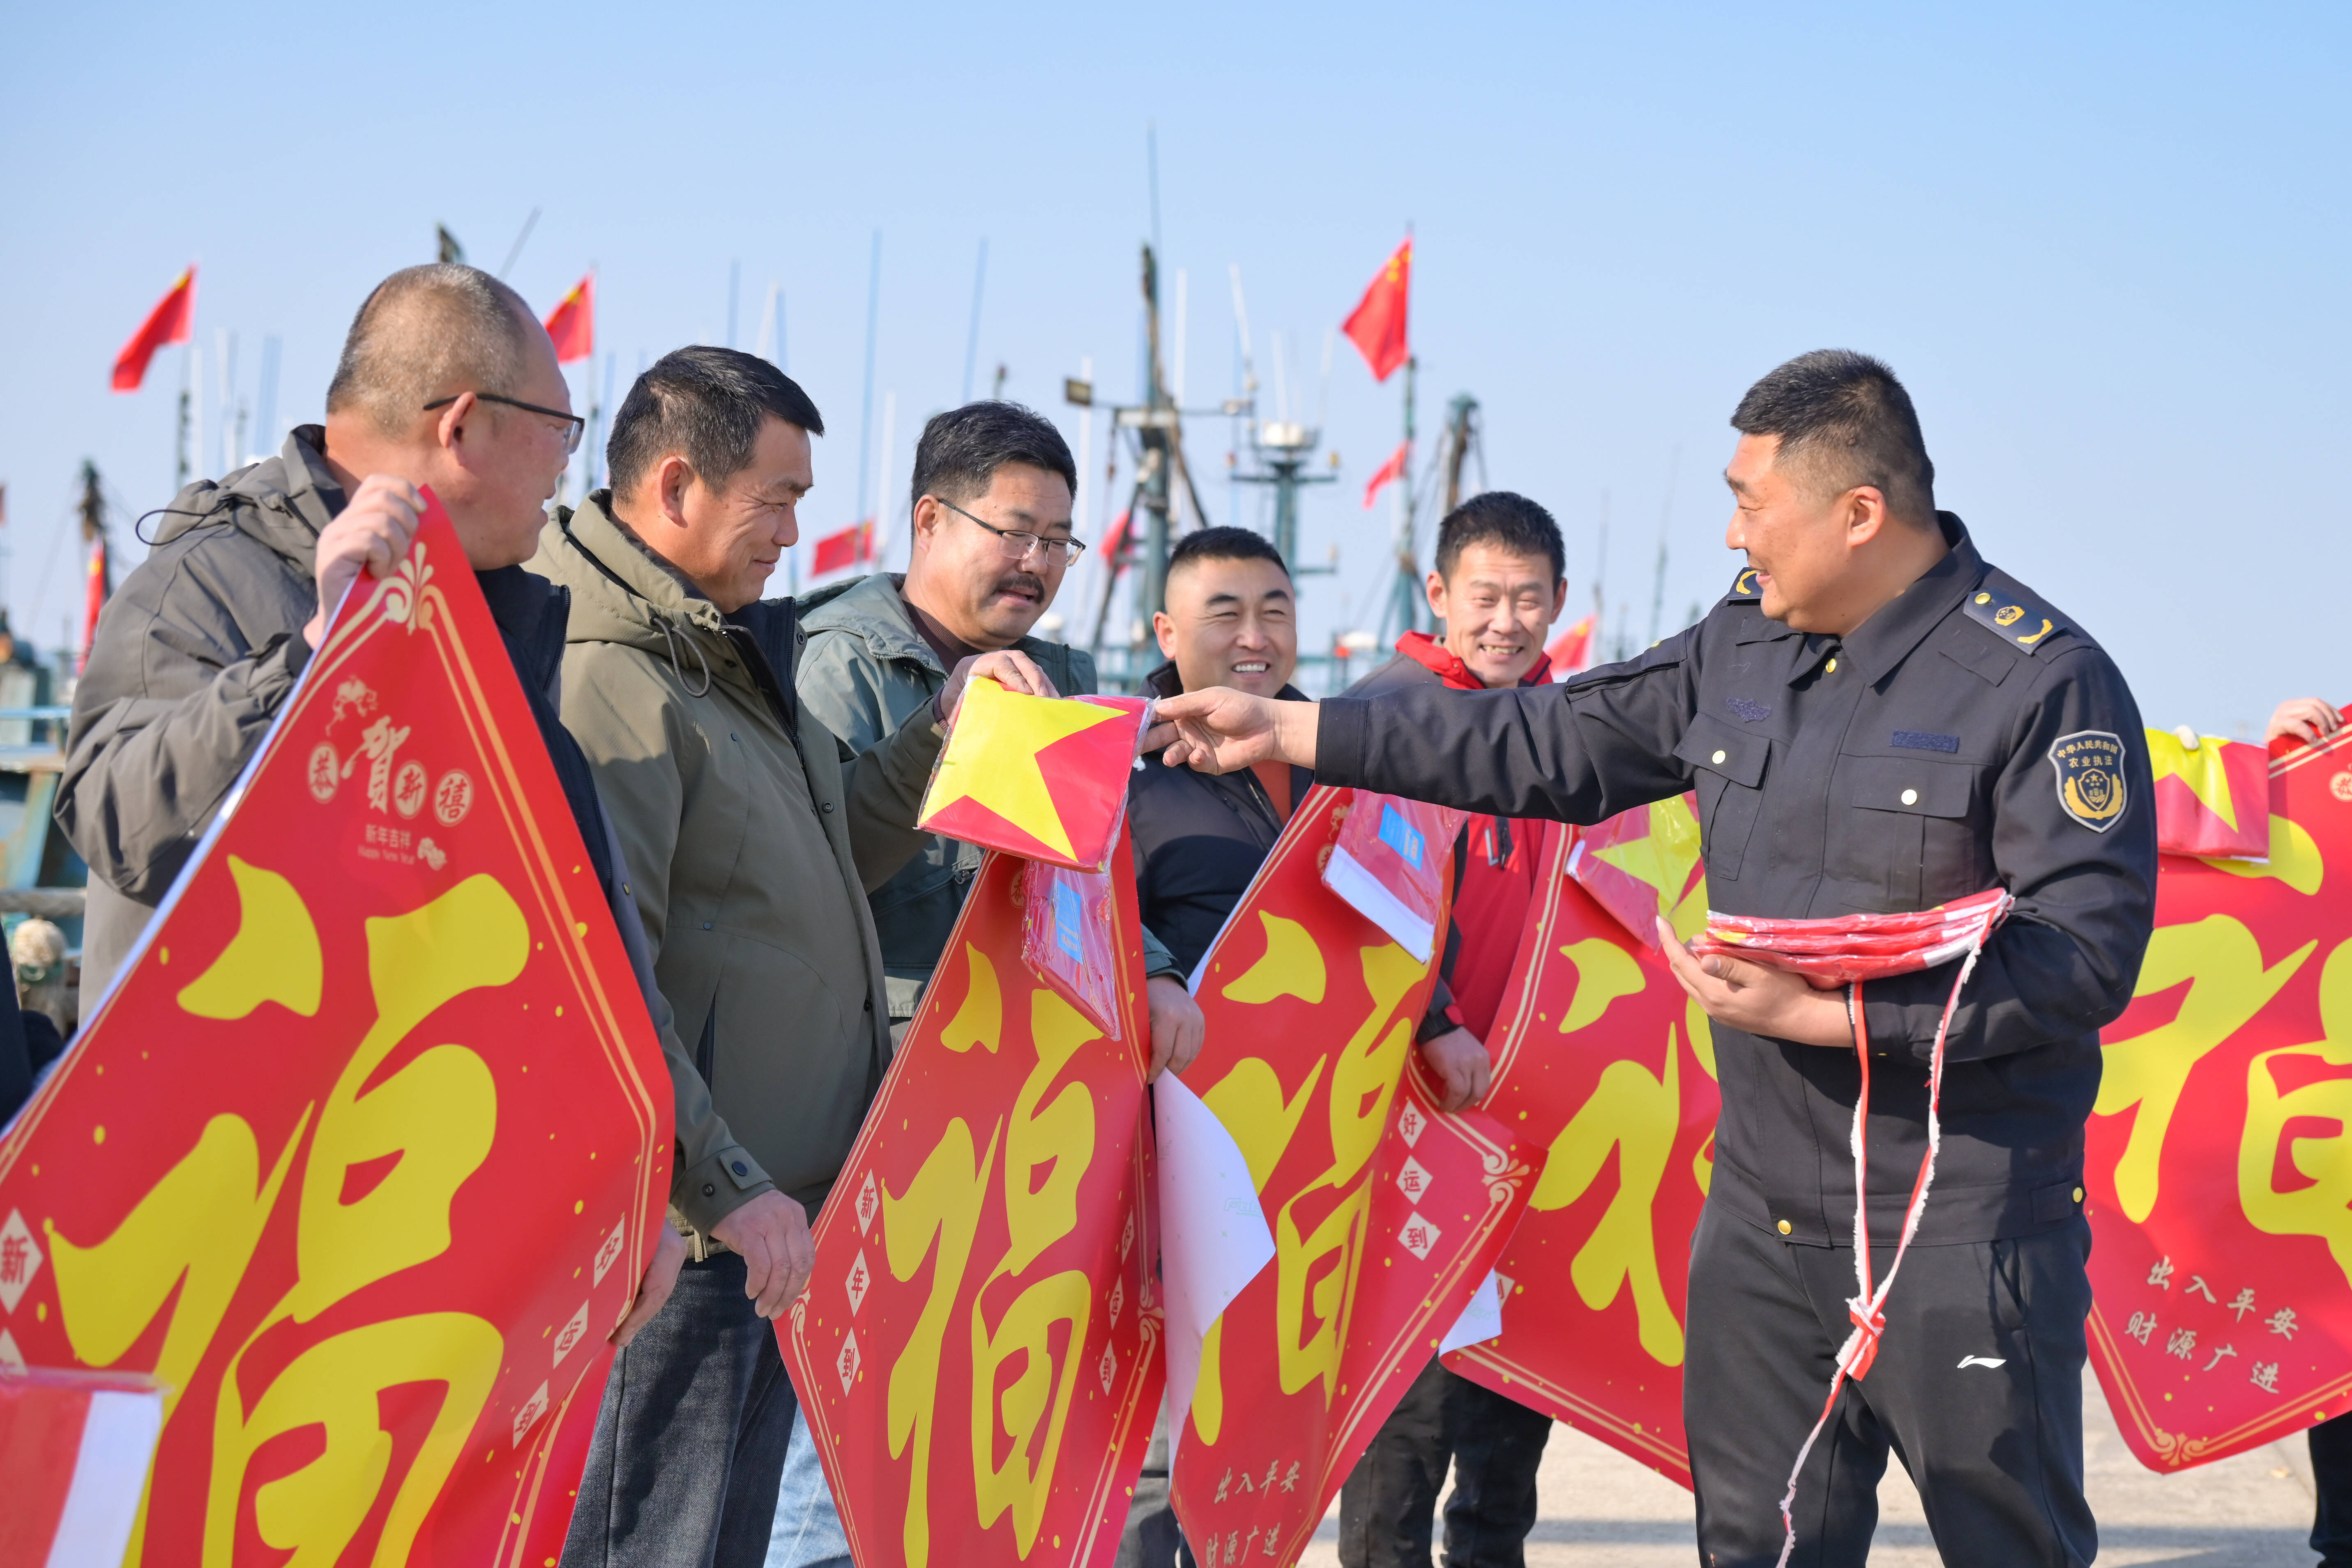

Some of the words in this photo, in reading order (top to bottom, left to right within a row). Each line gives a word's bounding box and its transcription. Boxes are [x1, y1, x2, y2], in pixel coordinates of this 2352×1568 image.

[2057, 740, 2118, 758] 中华人民共和国
[2068, 755, 2113, 768] 农业执法
[366, 824, 410, 849] 新年吉祥
[48, 854, 530, 1568] 福
[1192, 909, 1433, 1446] 福
[1403, 1113, 1429, 1250] 好运到
[842, 1185, 875, 1381] 新年到
[882, 940, 1103, 1568] 福
[514, 1236, 620, 1434] 好运到
[2147, 1255, 2299, 1341] 出入平安
[2124, 1310, 2280, 1394] 财源广进
[1214, 1459, 1300, 1504] 出入平安
[1206, 1522, 1281, 1568] 财源广进
